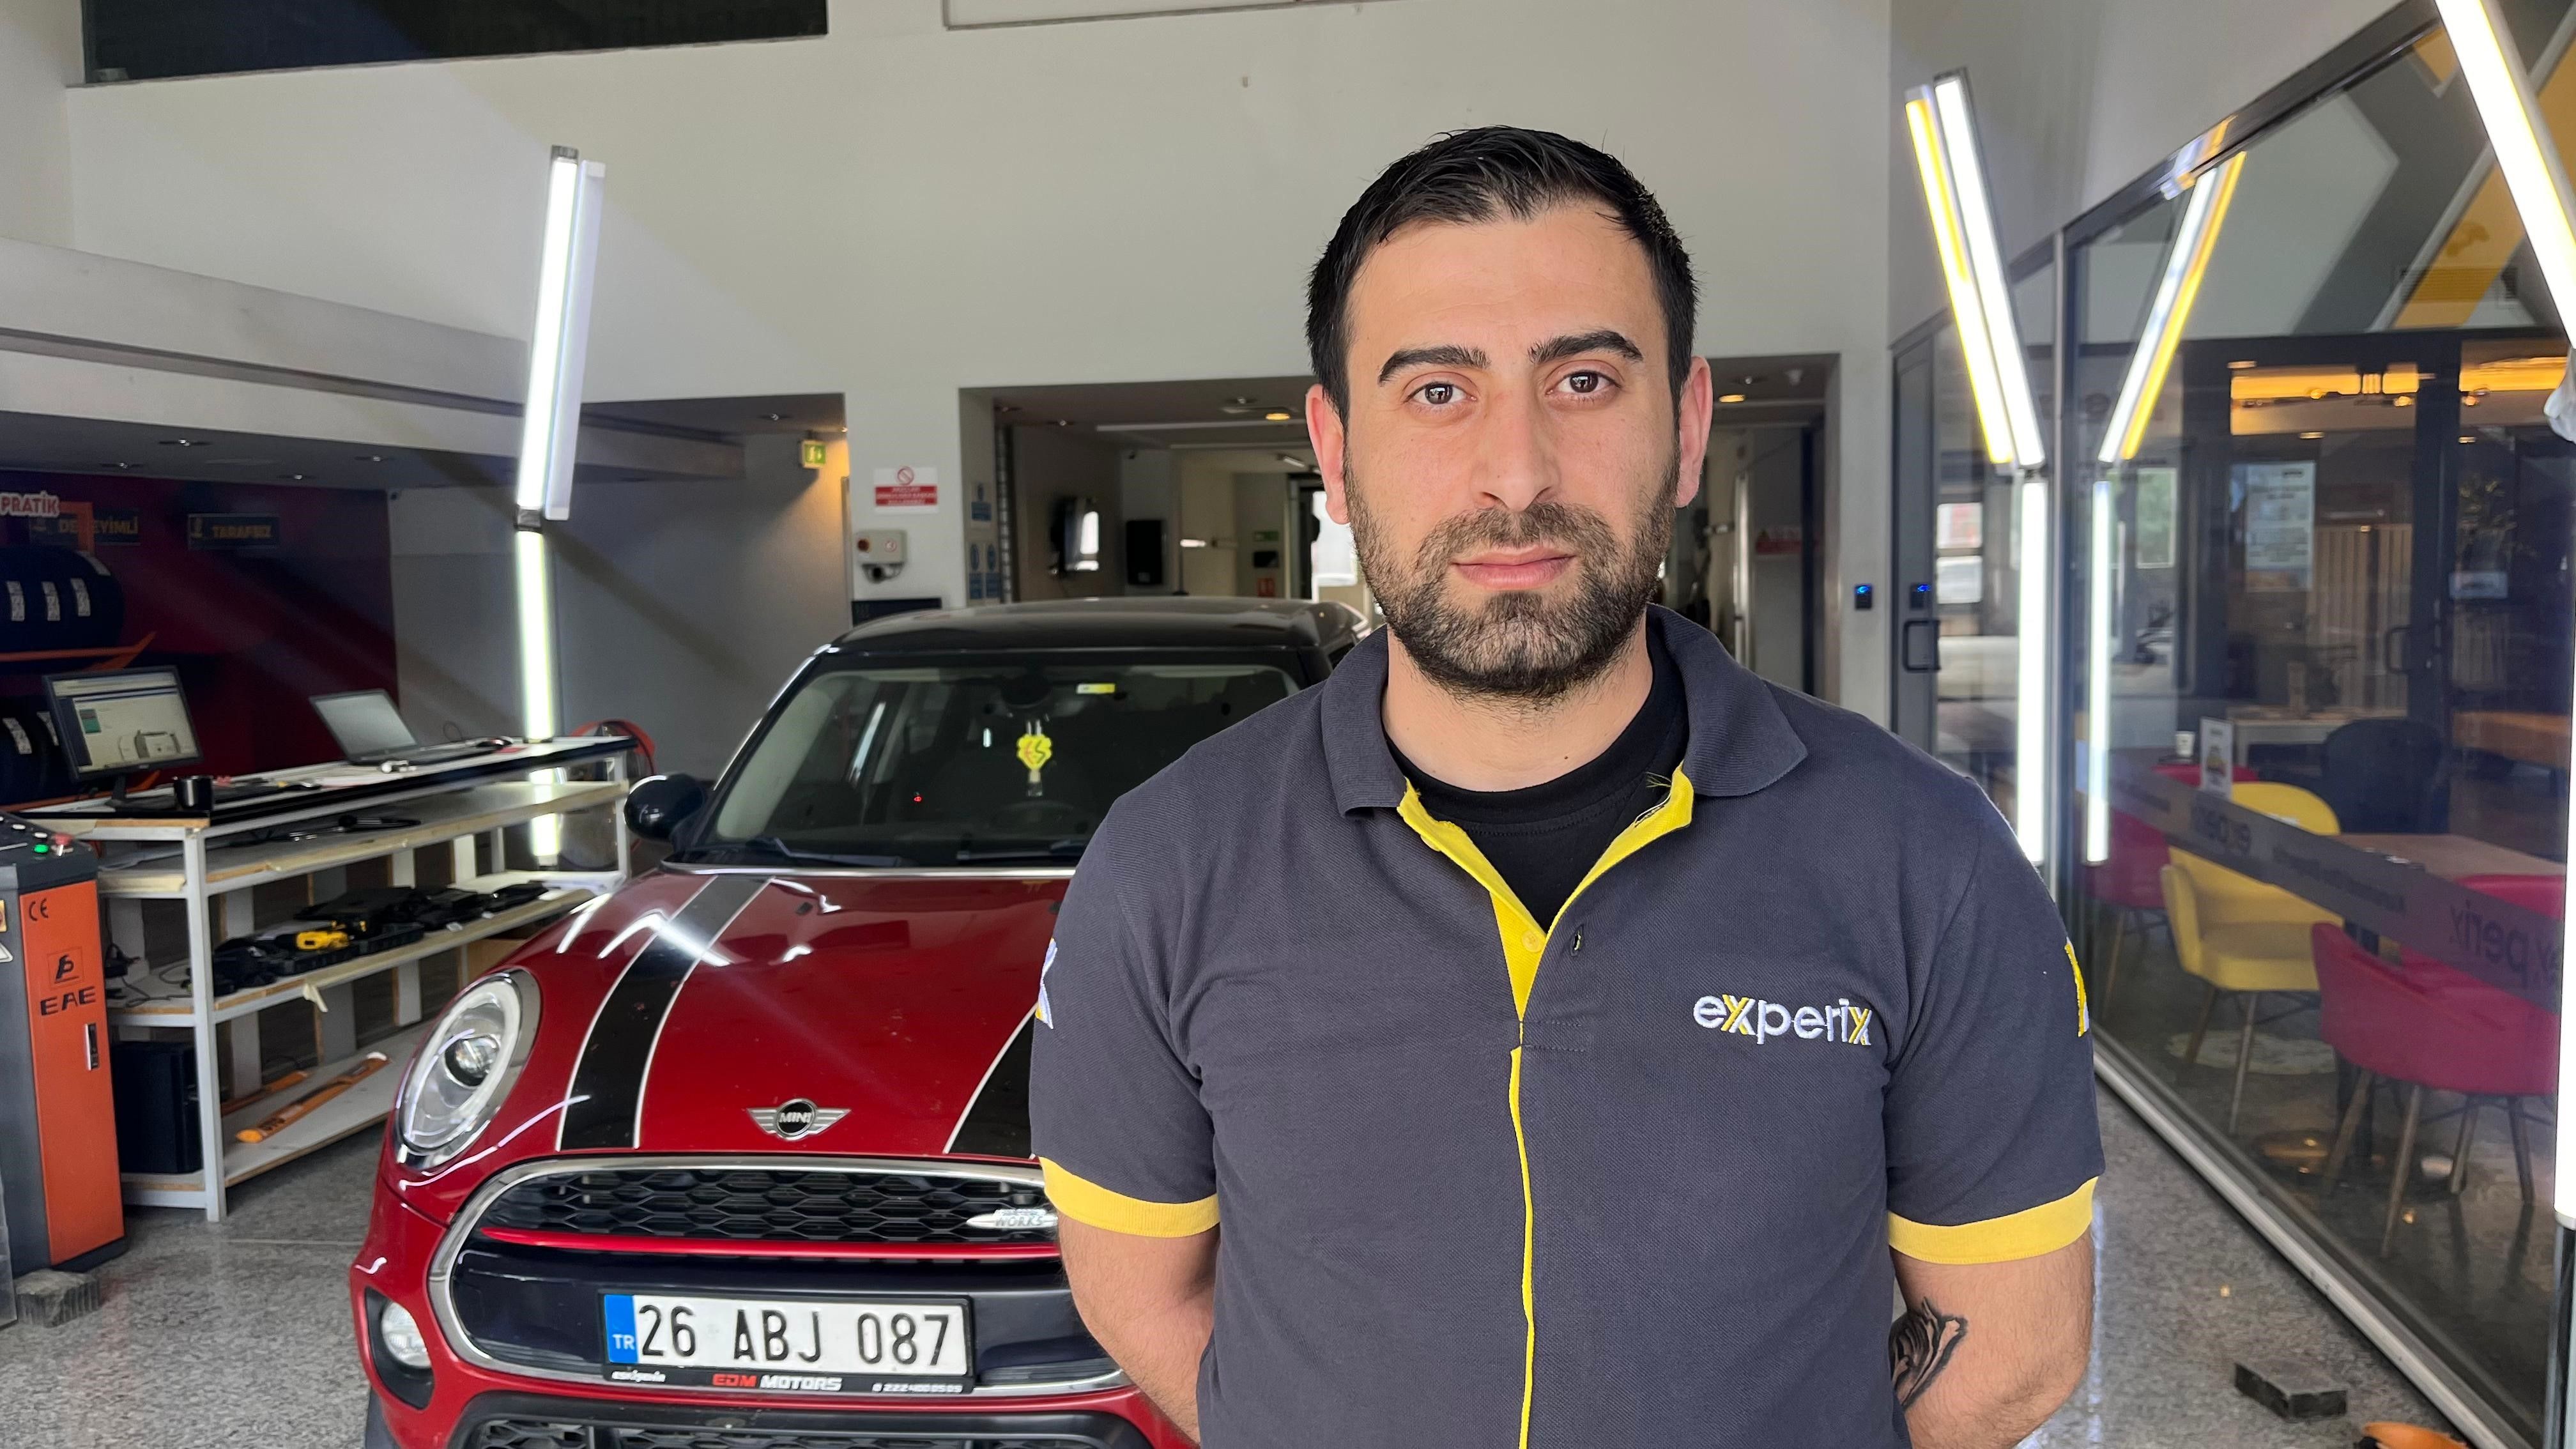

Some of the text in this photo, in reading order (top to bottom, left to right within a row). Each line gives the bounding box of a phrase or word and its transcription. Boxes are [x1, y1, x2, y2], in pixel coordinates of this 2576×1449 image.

[1, 493, 57, 514] PRATİK
[59, 516, 139, 535] DEEYİMLİ
[40, 986, 96, 1016] EAE
[1693, 994, 1873, 1046] experix
[779, 1112, 812, 1123] MINI
[995, 1216, 1044, 1227] WORKS
[612, 1334, 635, 1350] TR
[640, 1305, 949, 1366] 26 ABJ 087
[712, 1374, 843, 1392] EDM MOTORS
